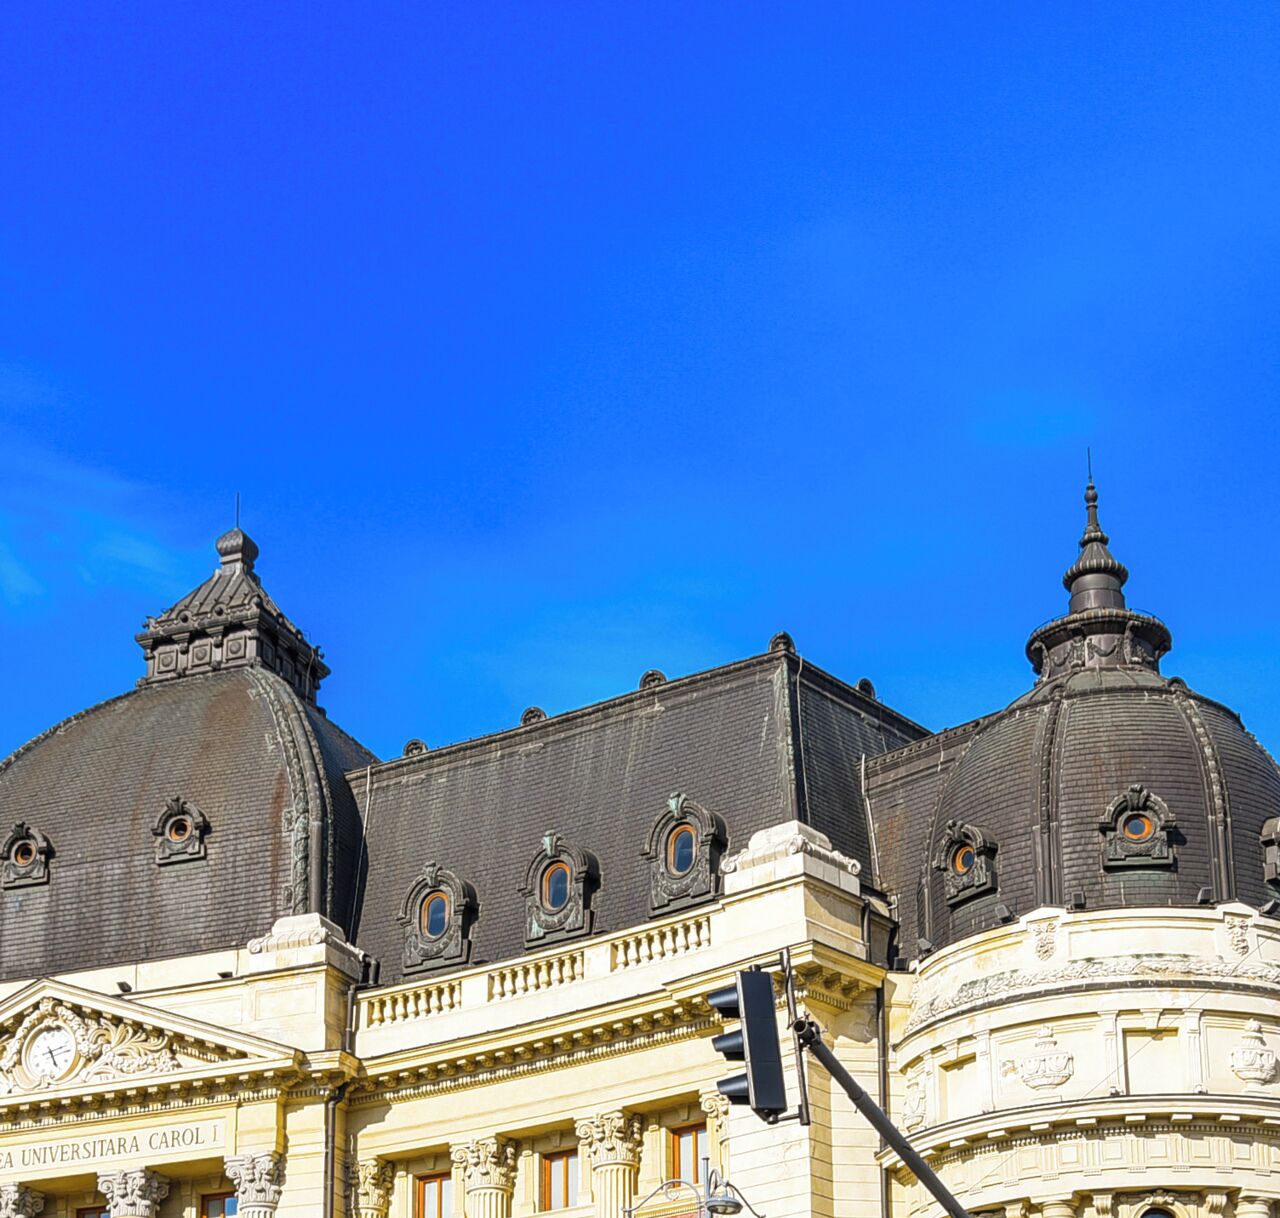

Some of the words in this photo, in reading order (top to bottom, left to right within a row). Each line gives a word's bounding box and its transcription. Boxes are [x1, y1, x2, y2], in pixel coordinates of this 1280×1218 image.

[21, 1135, 140, 1167] UNIVERSITARA
[148, 1127, 205, 1150] CAROL
[212, 1124, 219, 1142] I
